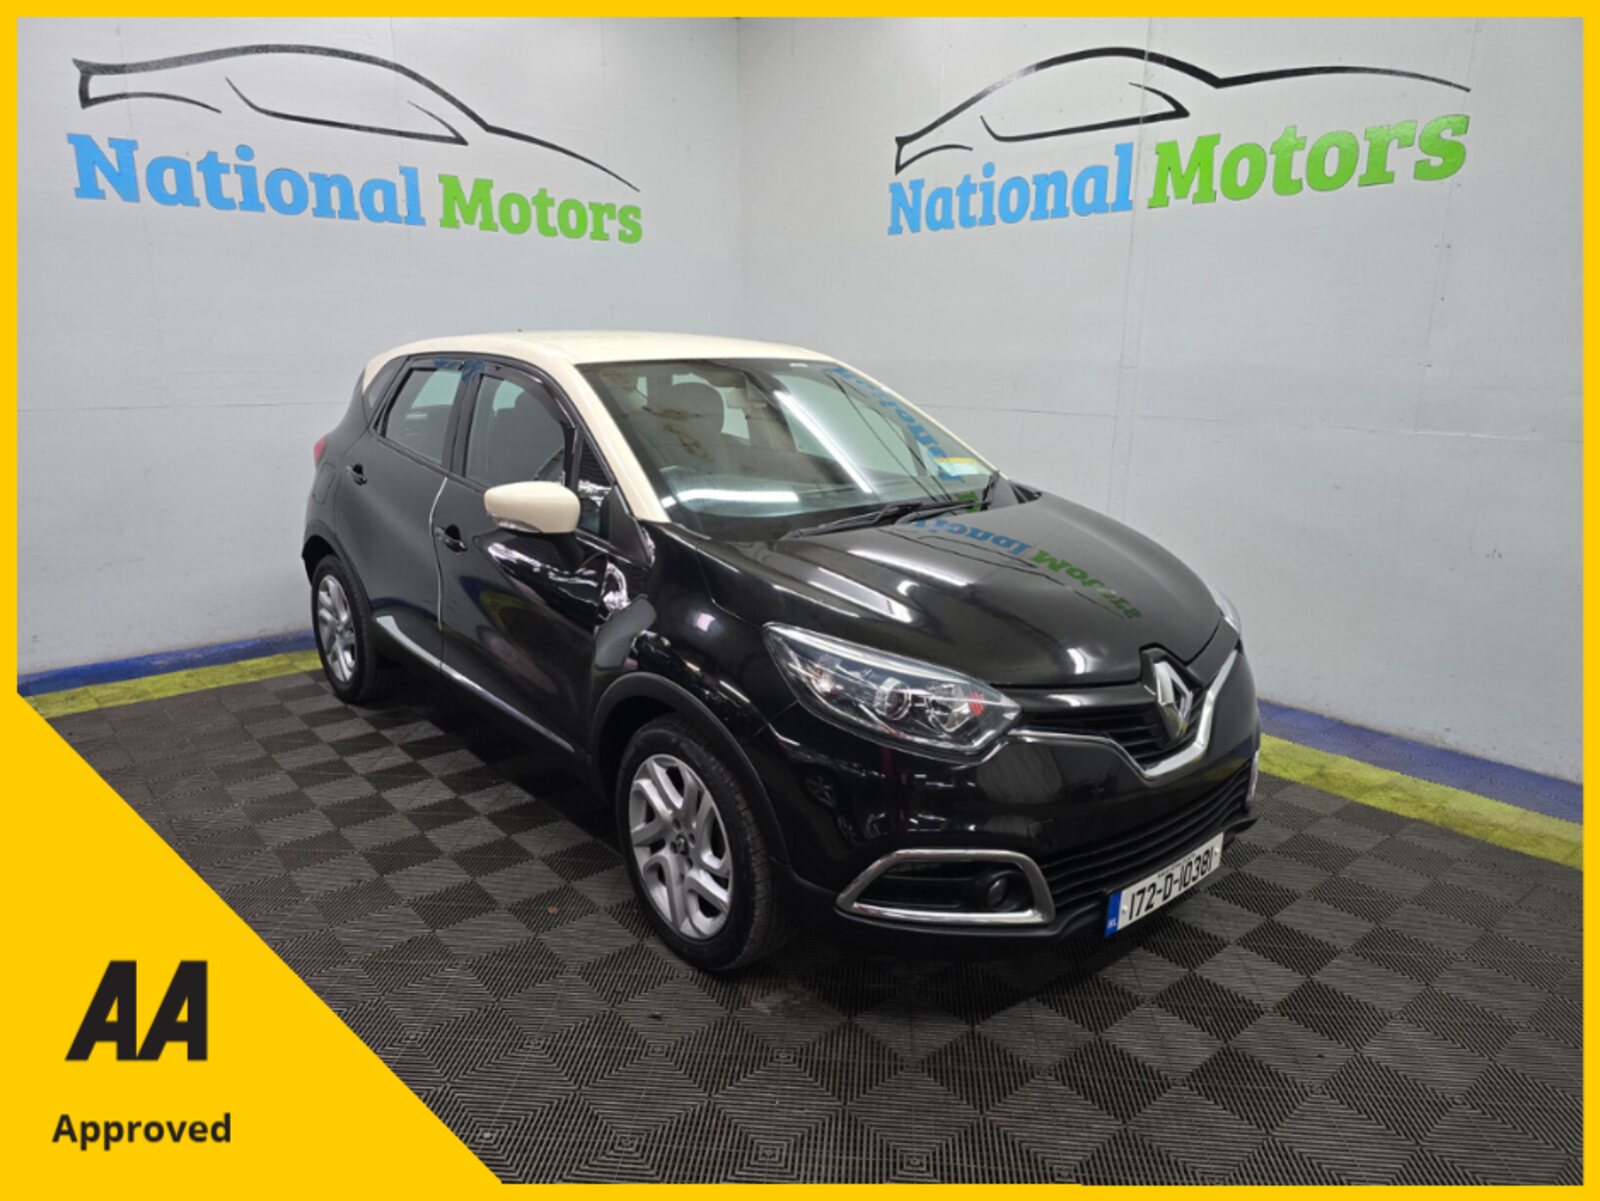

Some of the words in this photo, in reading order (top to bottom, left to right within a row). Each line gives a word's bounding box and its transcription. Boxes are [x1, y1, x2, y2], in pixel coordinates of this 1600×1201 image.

[69, 134, 426, 226] National
[440, 175, 642, 243] Motors
[888, 143, 1133, 235] National
[1148, 115, 1470, 209] Motors
[1128, 847, 1214, 921] 172-D-10381
